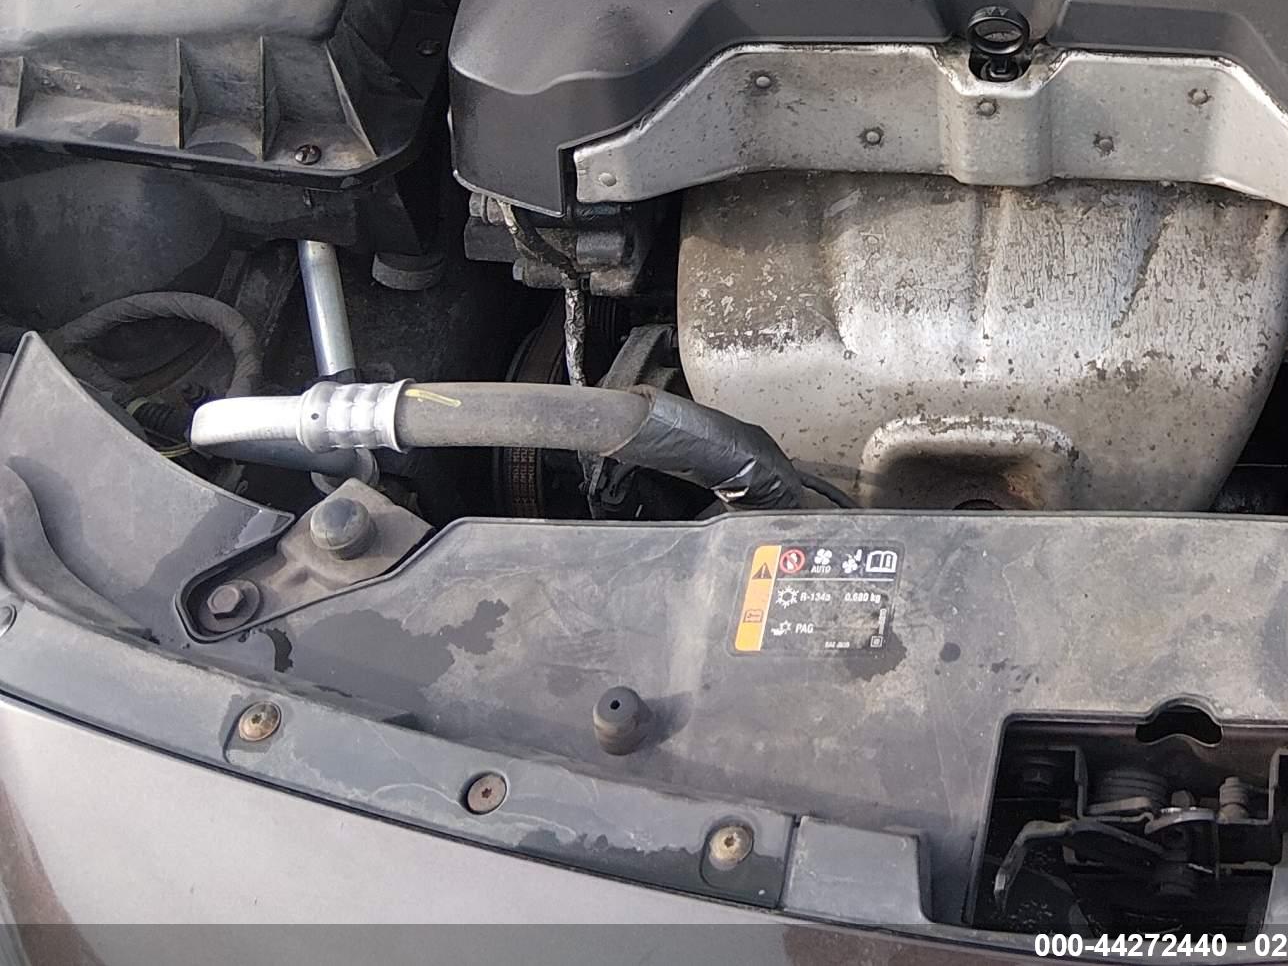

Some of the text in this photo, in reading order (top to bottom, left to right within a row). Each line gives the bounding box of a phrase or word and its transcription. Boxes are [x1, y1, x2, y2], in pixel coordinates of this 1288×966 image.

[811, 565, 831, 574] AUTO
[800, 592, 831, 602] R-134a
[869, 592, 881, 604] kg
[795, 623, 814, 634] PAG
